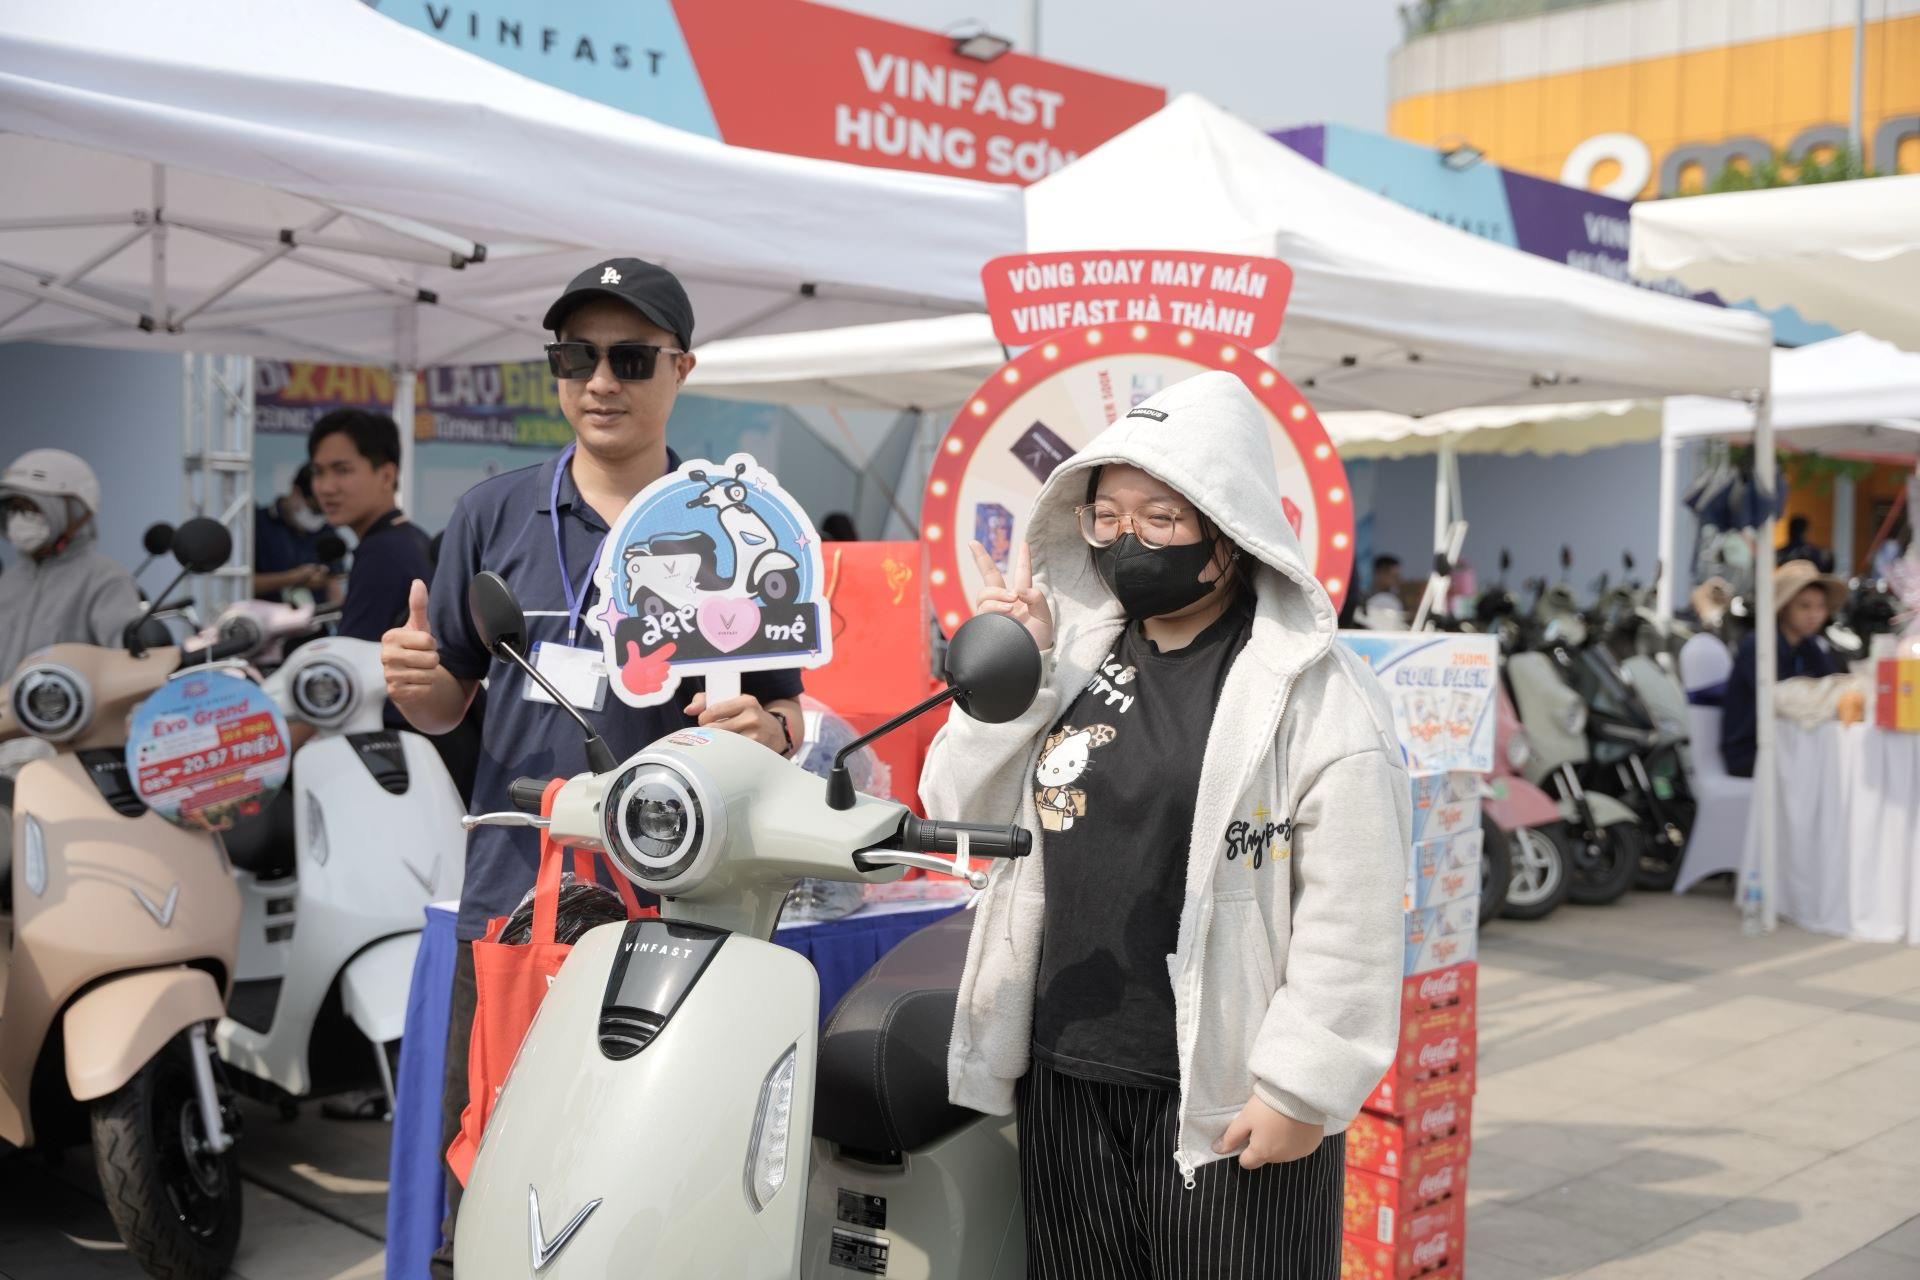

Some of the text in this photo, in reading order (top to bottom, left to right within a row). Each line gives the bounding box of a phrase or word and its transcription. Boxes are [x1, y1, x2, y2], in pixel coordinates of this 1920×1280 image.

[426, 3, 664, 76] VINFAST
[855, 47, 1064, 129] VINFAST
[835, 102, 976, 169] HÙNG
[600, 266, 622, 284] LA
[1008, 260, 1268, 299] VÒNG XOAY MAY MẮN
[1011, 294, 1255, 337] VINFAST HÀ THÀNH
[765, 614, 807, 643] mê
[152, 717, 188, 738] Evo
[194, 699, 248, 726] Grand
[625, 943, 692, 958] VINFAST
